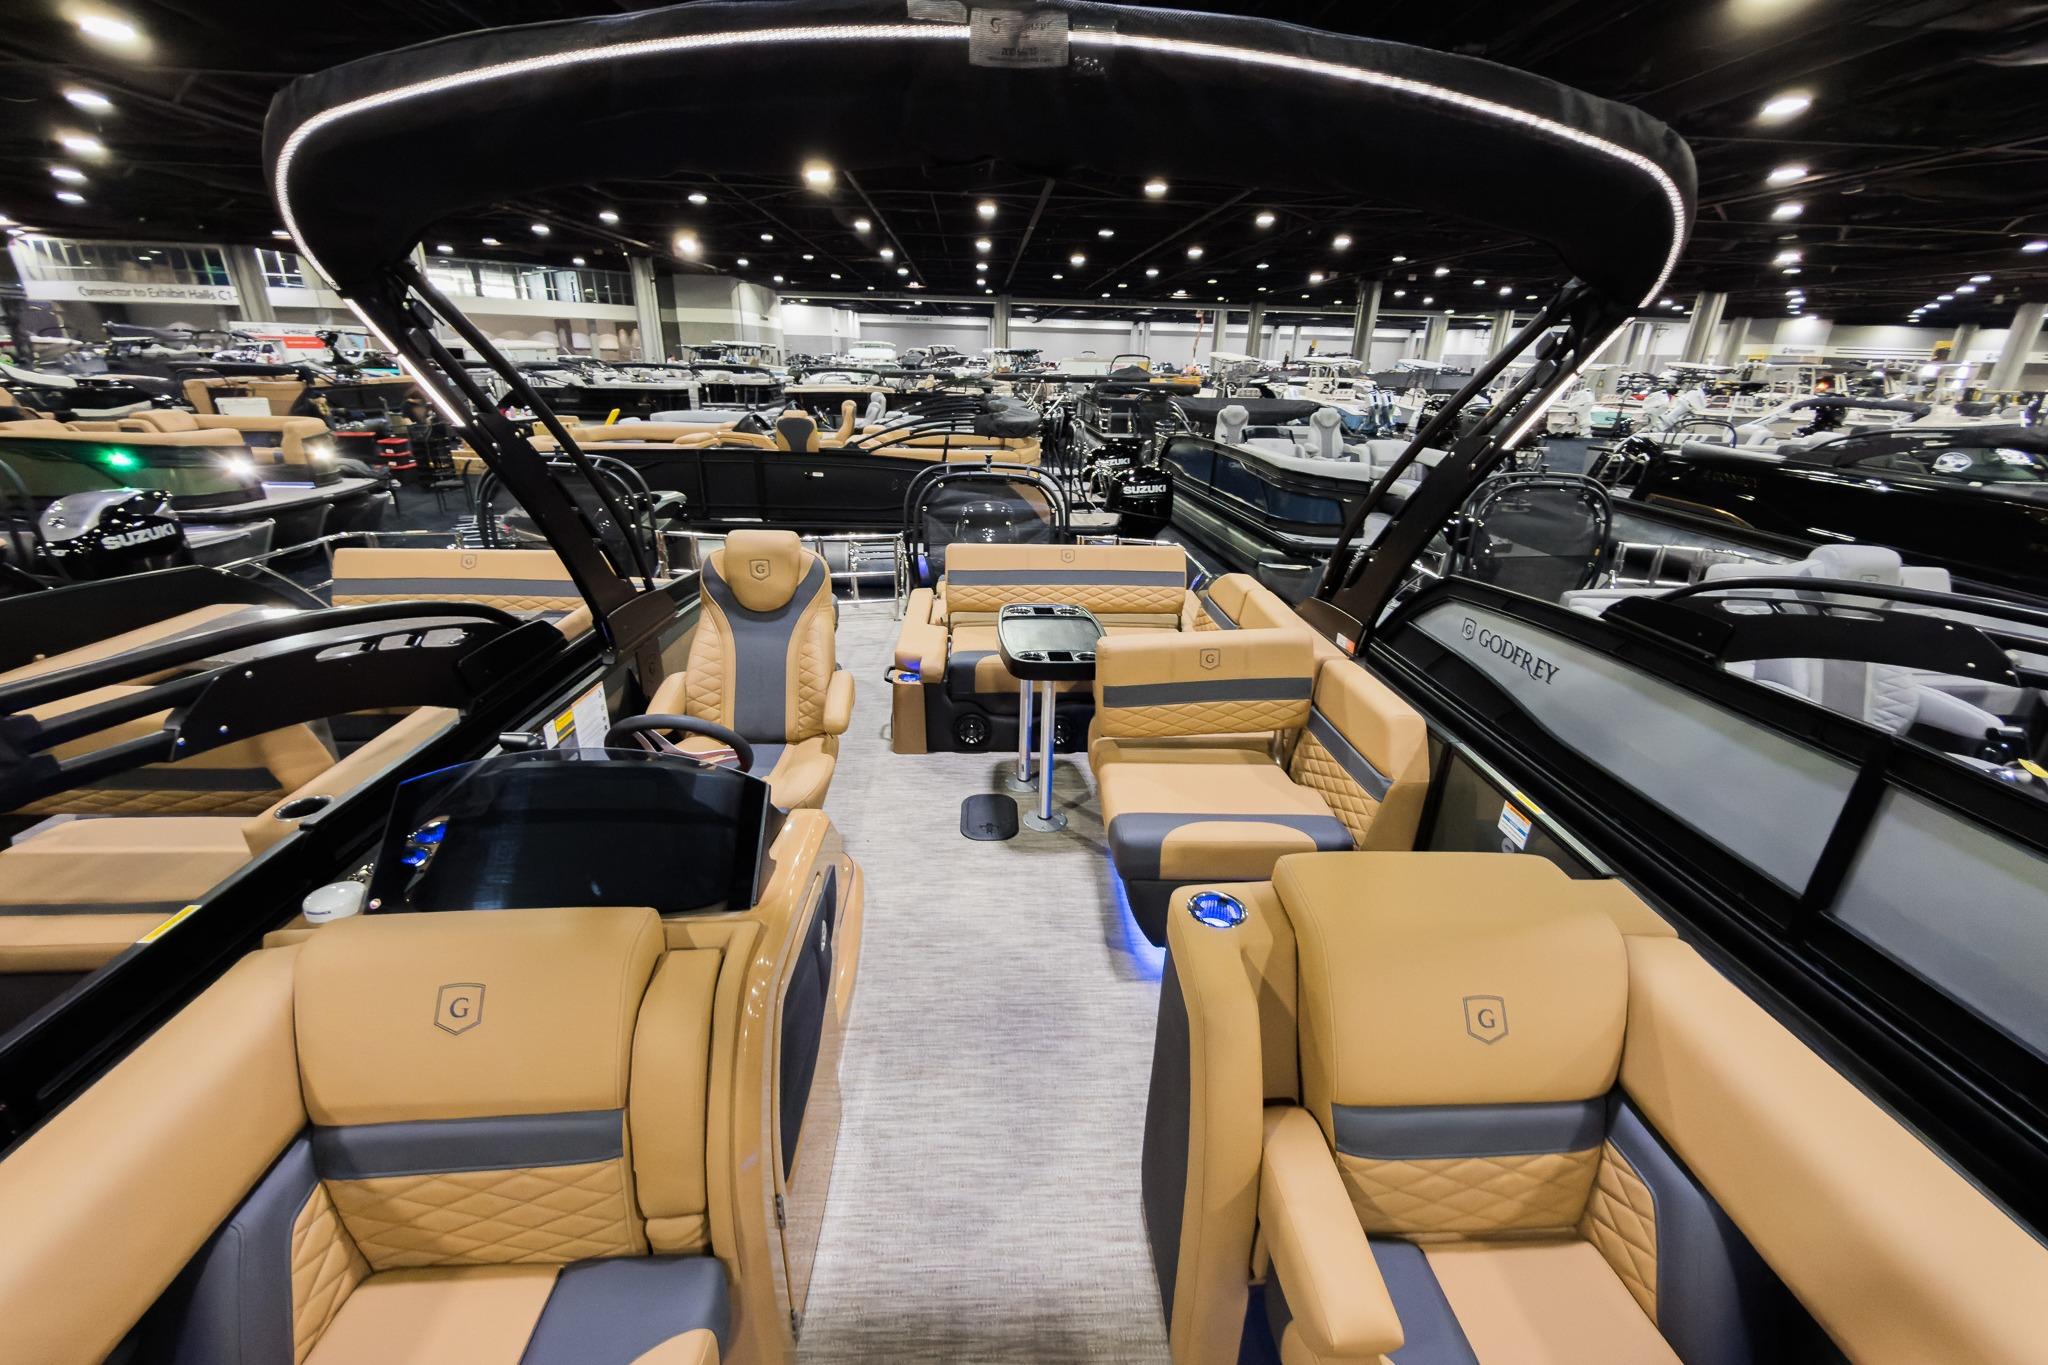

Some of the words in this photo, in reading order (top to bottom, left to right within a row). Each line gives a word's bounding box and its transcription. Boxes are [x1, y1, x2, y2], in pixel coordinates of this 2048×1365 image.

[133, 287, 146, 297] to
[1122, 484, 1167, 495] SUZUKI
[100, 523, 177, 551] SUZUKI
[1478, 628, 1561, 685] GODFREY
[449, 996, 470, 1019] G
[1477, 1008, 1496, 1029] G
